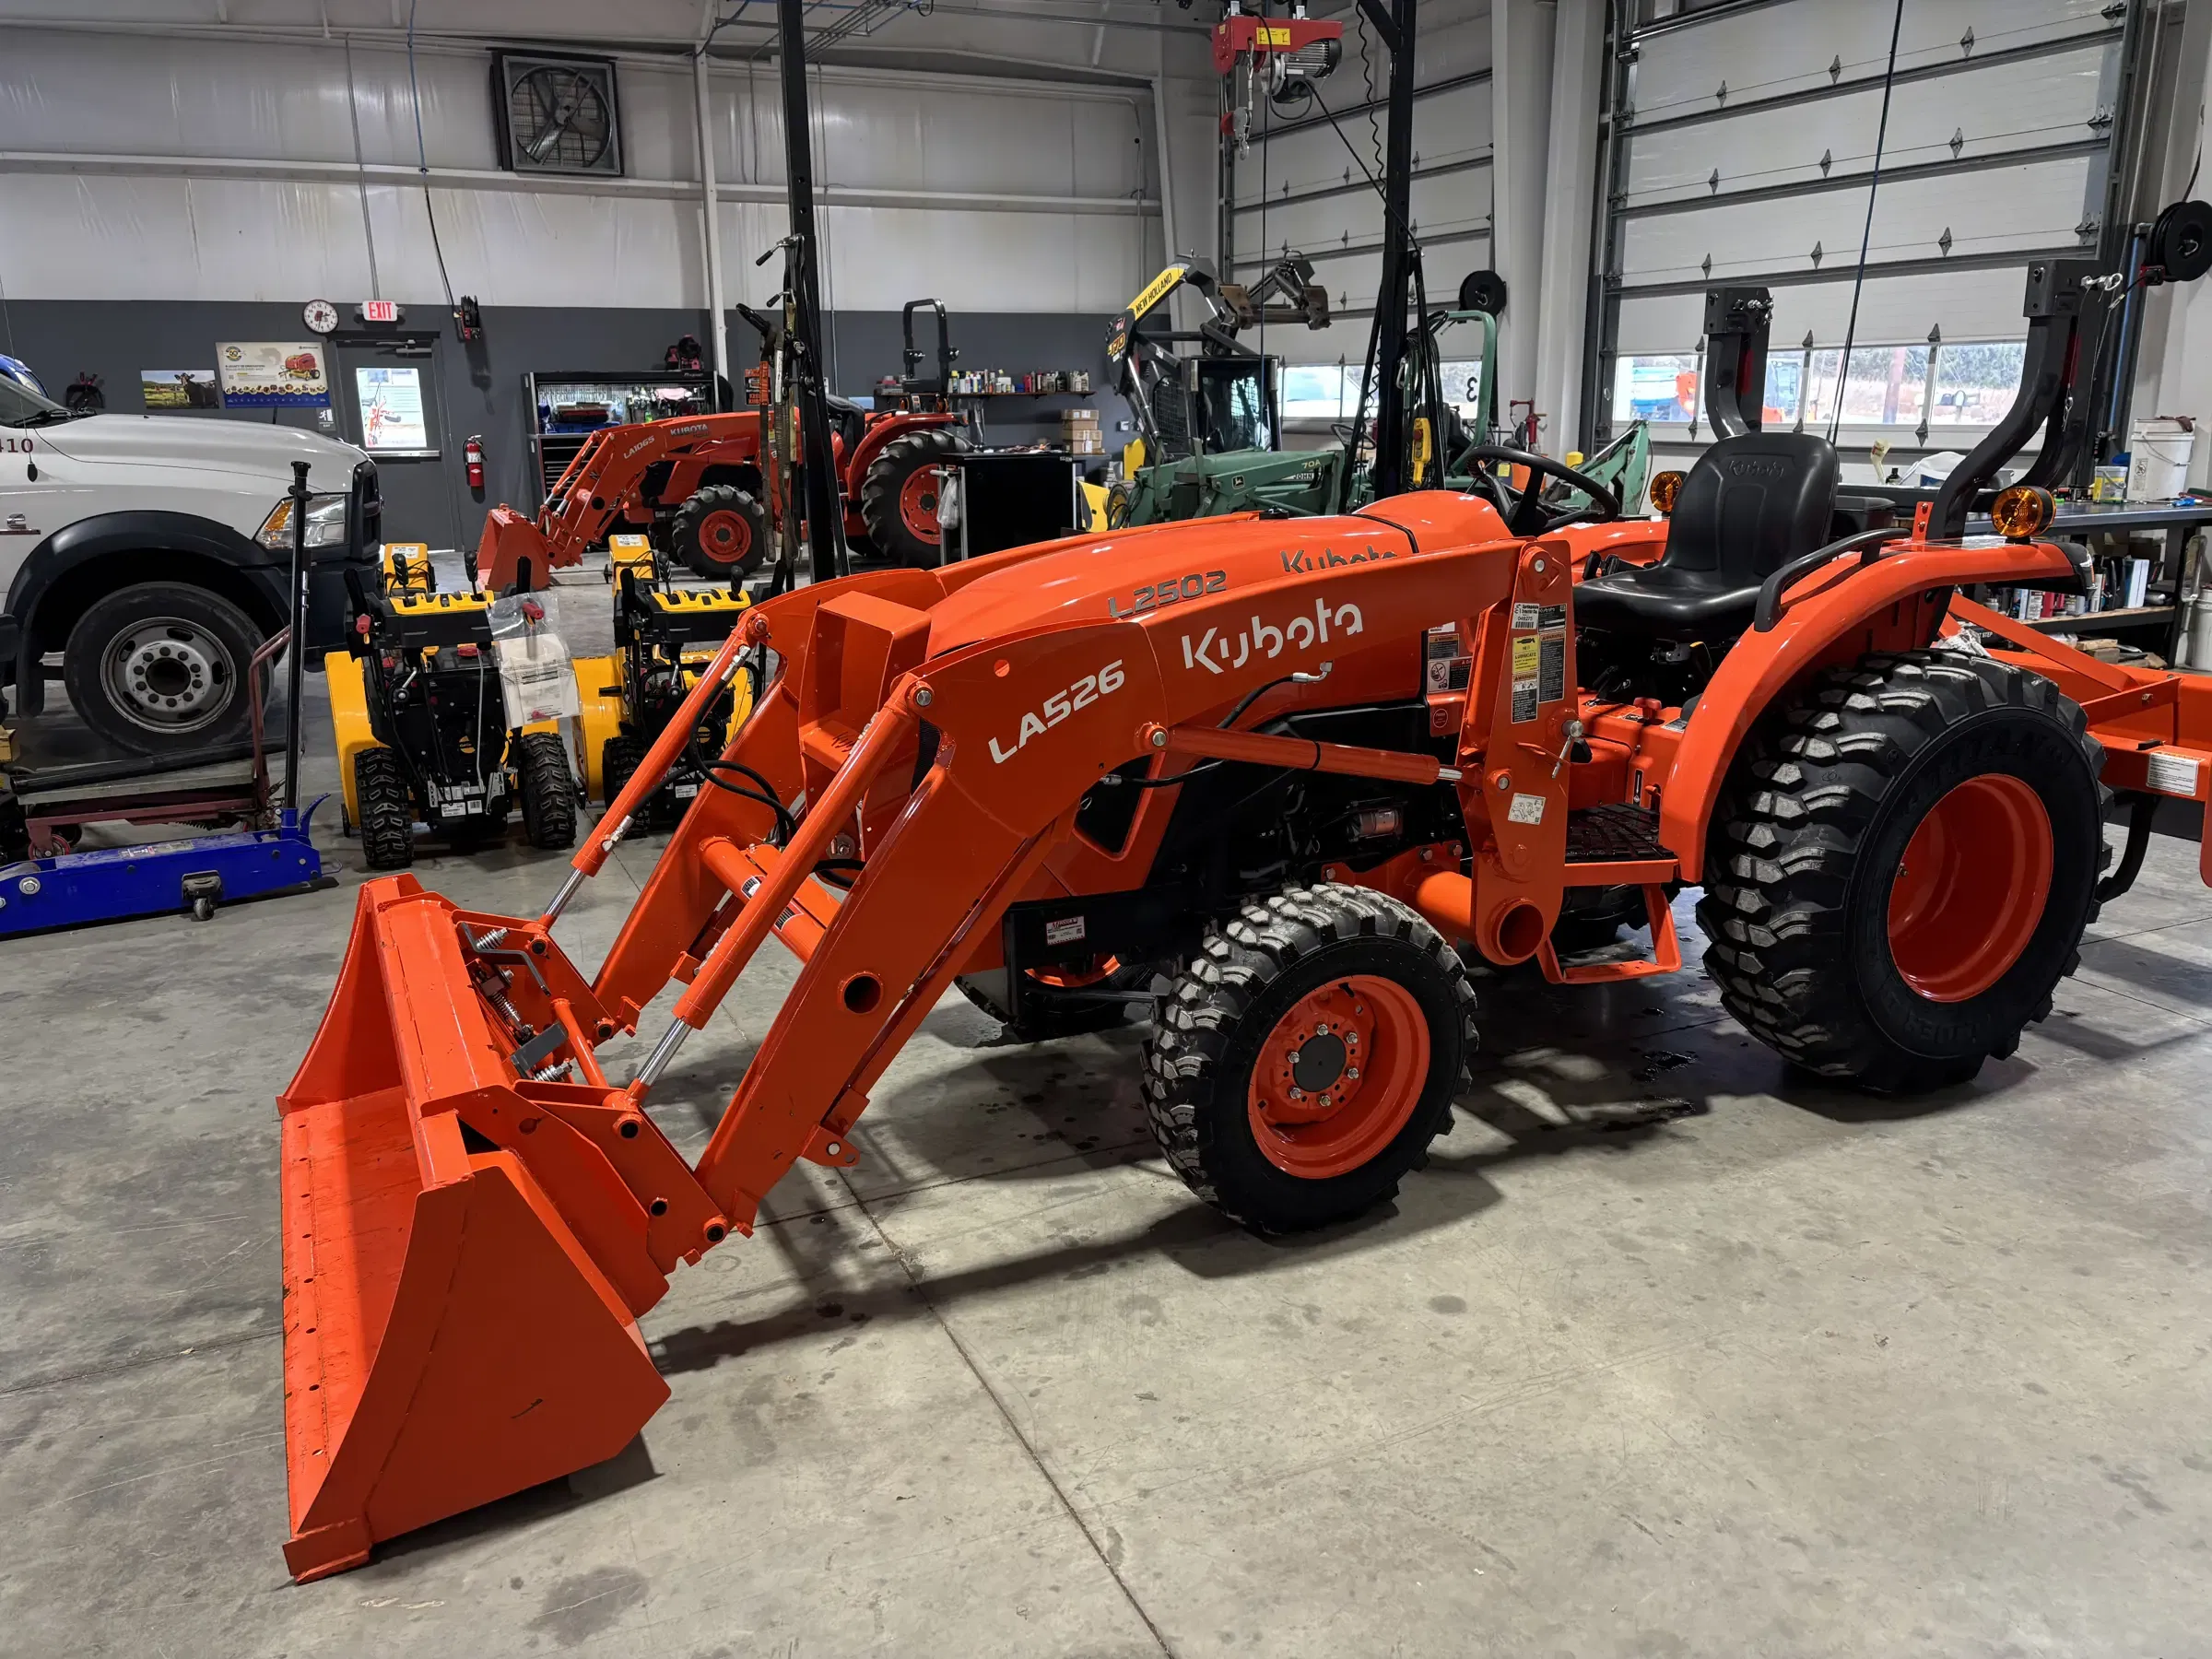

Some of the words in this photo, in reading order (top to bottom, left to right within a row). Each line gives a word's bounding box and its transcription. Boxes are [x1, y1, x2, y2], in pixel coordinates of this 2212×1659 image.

[1135, 297, 1148, 314] NEW
[1147, 272, 1172, 303] HOLLAND
[369, 301, 392, 320] EXIT
[670, 423, 709, 437] KUBOTA
[1293, 472, 1314, 480] JOHN
[1301, 459, 1322, 469] 70A
[1108, 570, 1227, 618] L2502
[1182, 597, 1364, 675] Kubota
[988, 658, 1125, 764] LA526
